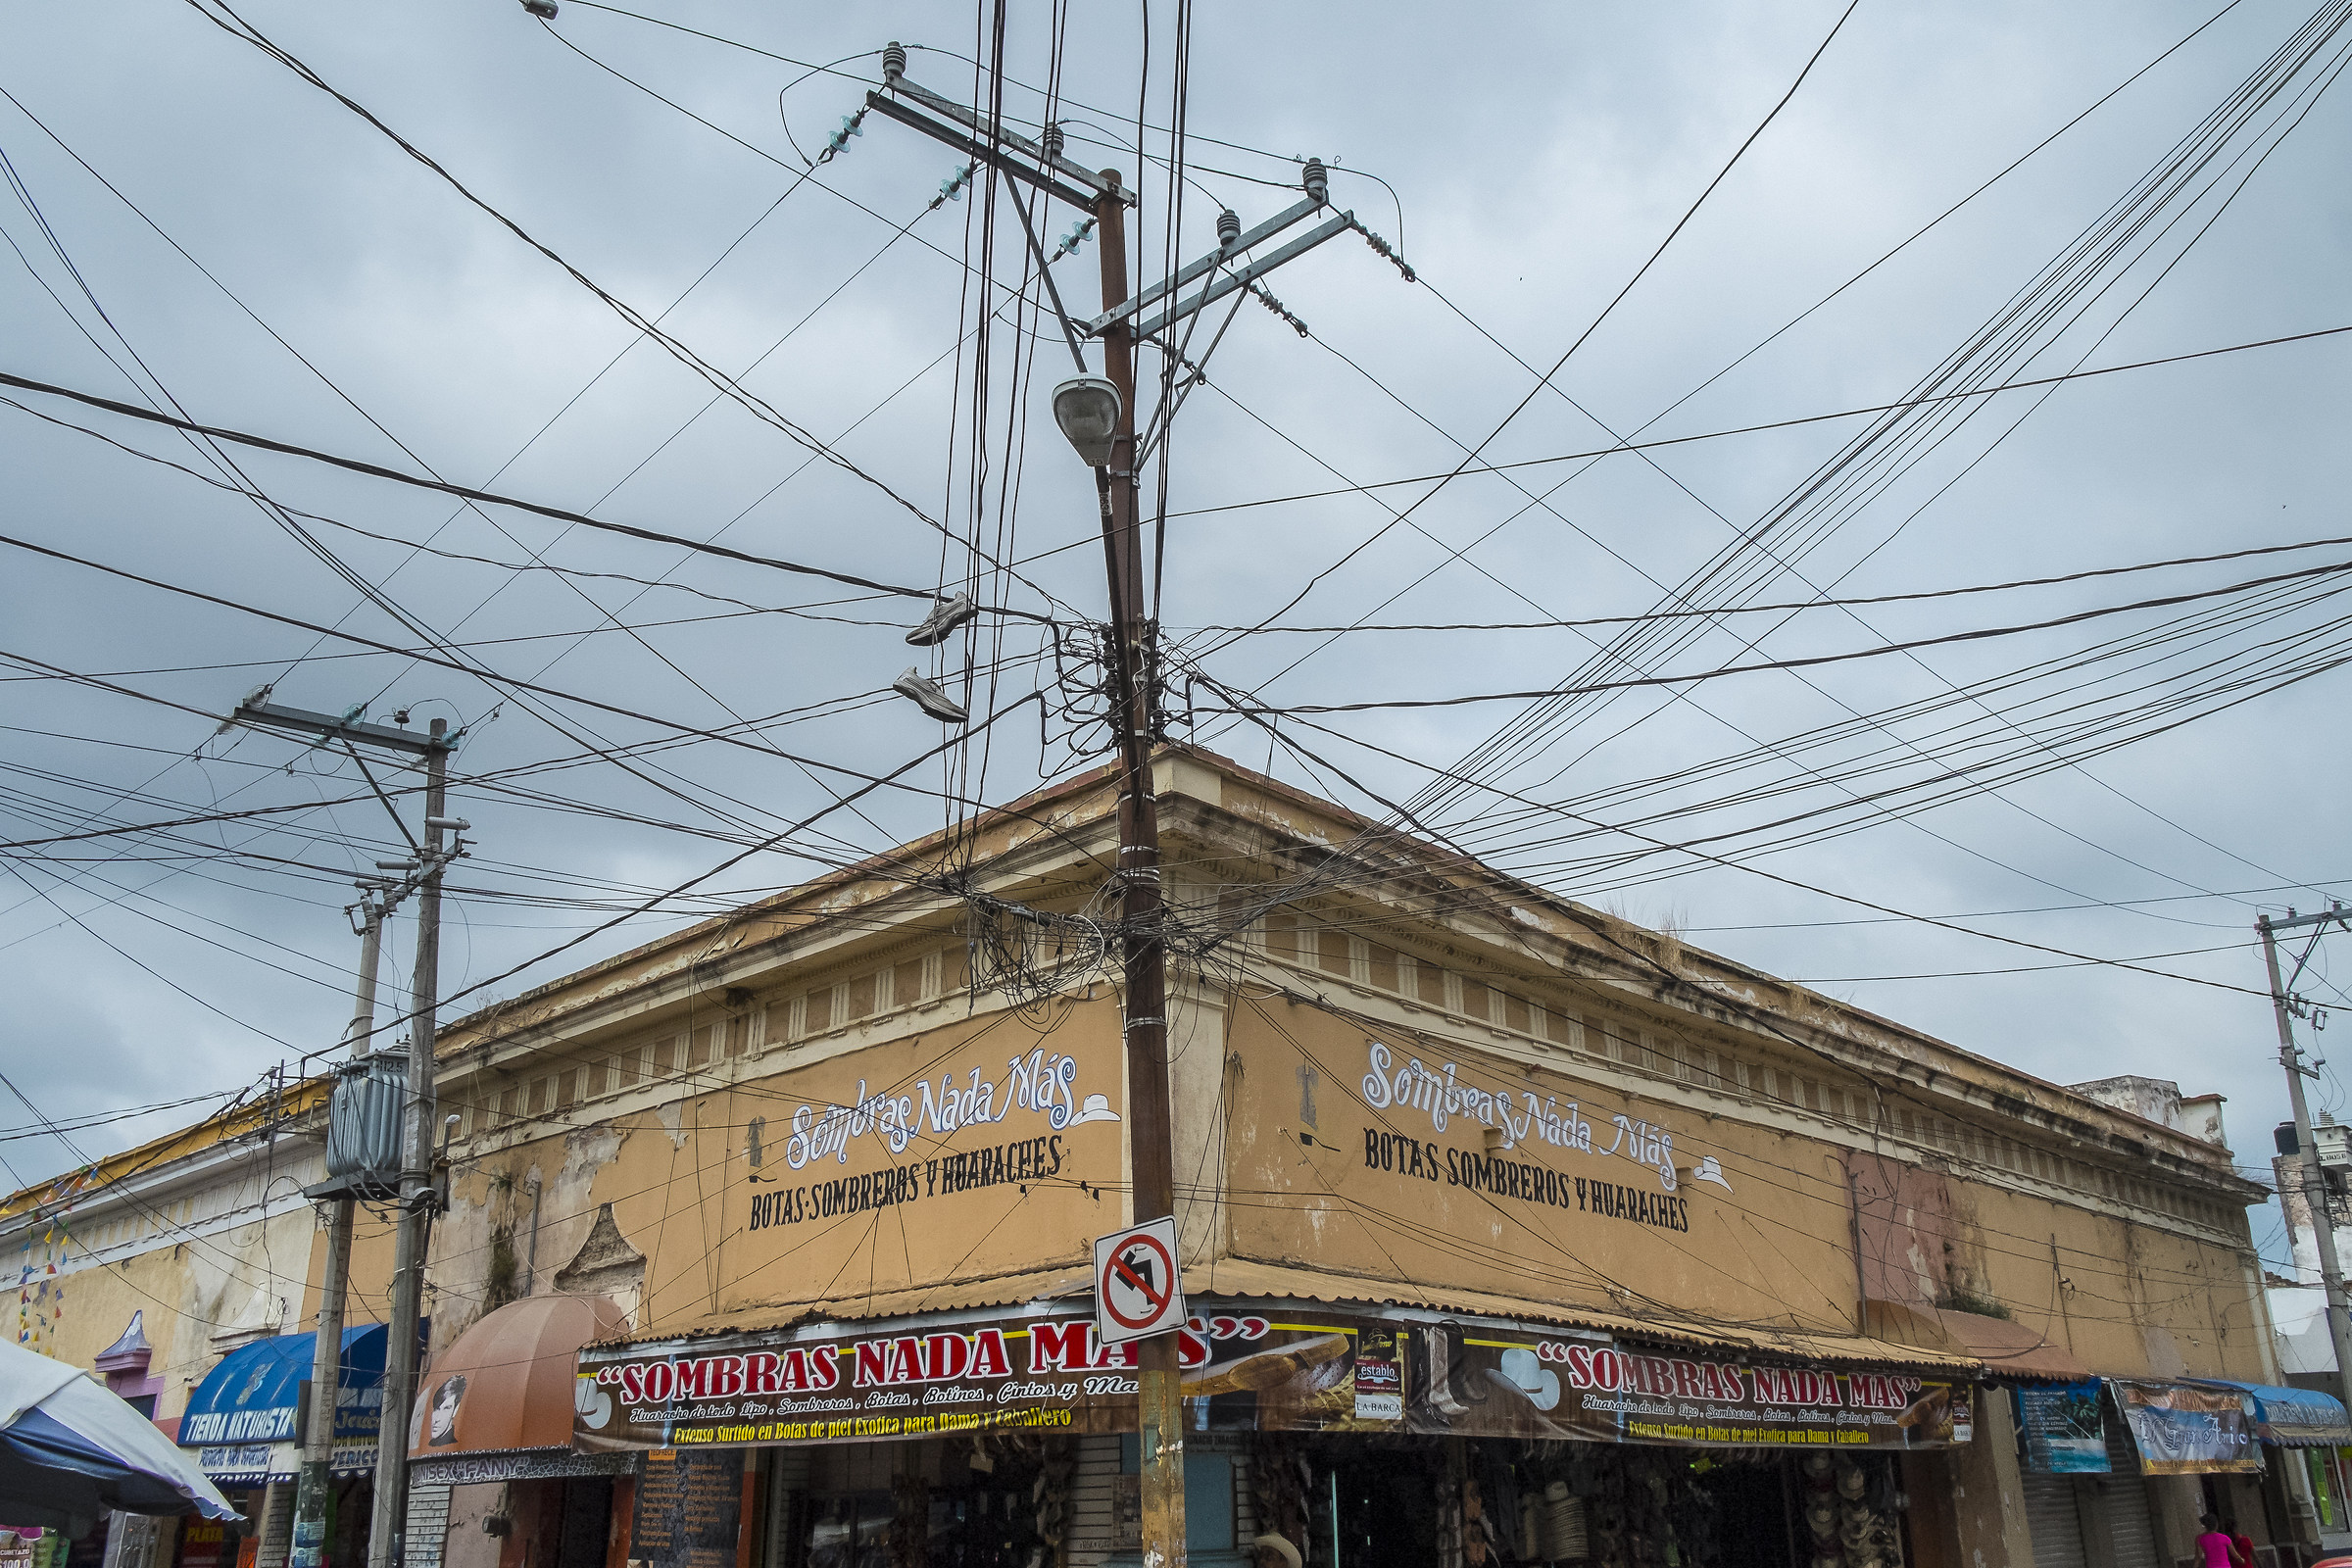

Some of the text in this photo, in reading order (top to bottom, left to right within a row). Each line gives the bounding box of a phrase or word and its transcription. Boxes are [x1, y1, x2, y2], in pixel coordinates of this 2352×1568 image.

[786, 1048, 1076, 1170] Sombras Nada Más
[1362, 1042, 1677, 1192] Sombras Nada Más
[808, 1162, 919, 1220] SOMBREROS
[925, 1161, 936, 1198] Y
[942, 1135, 1062, 1193] HUARACHES
[1363, 1128, 1689, 1233] BOTAS SOMBREROS Y HUARACHES
[853, 1328, 1012, 1388] NADA
[1361, 1364, 1396, 1377] establo
[630, 1408, 688, 1422] Huarache
[689, 1406, 705, 1420] de
[705, 1403, 735, 1418] todo
[997, 1381, 1055, 1403] Cintos
[1056, 1382, 1078, 1401] y
[1083, 1375, 1139, 1396] Ma
[1582, 1394, 1638, 1412] Huarache
[1639, 1400, 1651, 1414] de
[1651, 1400, 1675, 1415] todo
[1751, 1366, 1843, 1406] NADA
[185, 1406, 293, 1442] TIENDA NATURISTA
[674, 1426, 713, 1445] Extenso
[716, 1423, 756, 1443] Surtido
[758, 1425, 772, 1441] en
[775, 1422, 808, 1440] Botas
[809, 1420, 825, 1439] de
[855, 1415, 900, 1436] Exotica
[904, 1415, 938, 1436] para
[939, 1411, 981, 1432] Dama
[996, 1406, 1072, 1428] Caballero
[1356, 1402, 1401, 1412] LA BARCA
[1629, 1421, 1662, 1438] Extenso
[1664, 1423, 1693, 1440] Surtido
[1695, 1427, 1705, 1441] en
[1707, 1425, 1730, 1442] Botas
[1731, 1426, 1740, 1442] de
[1742, 1427, 1757, 1443] piel
[1758, 1428, 1787, 1443] Exotica
[1788, 1430, 1805, 1444] para
[1807, 1429, 1829, 1443] Dama
[1837, 1429, 1869, 1443] Caballero
[2202, 1414, 2248, 1446] Amio
